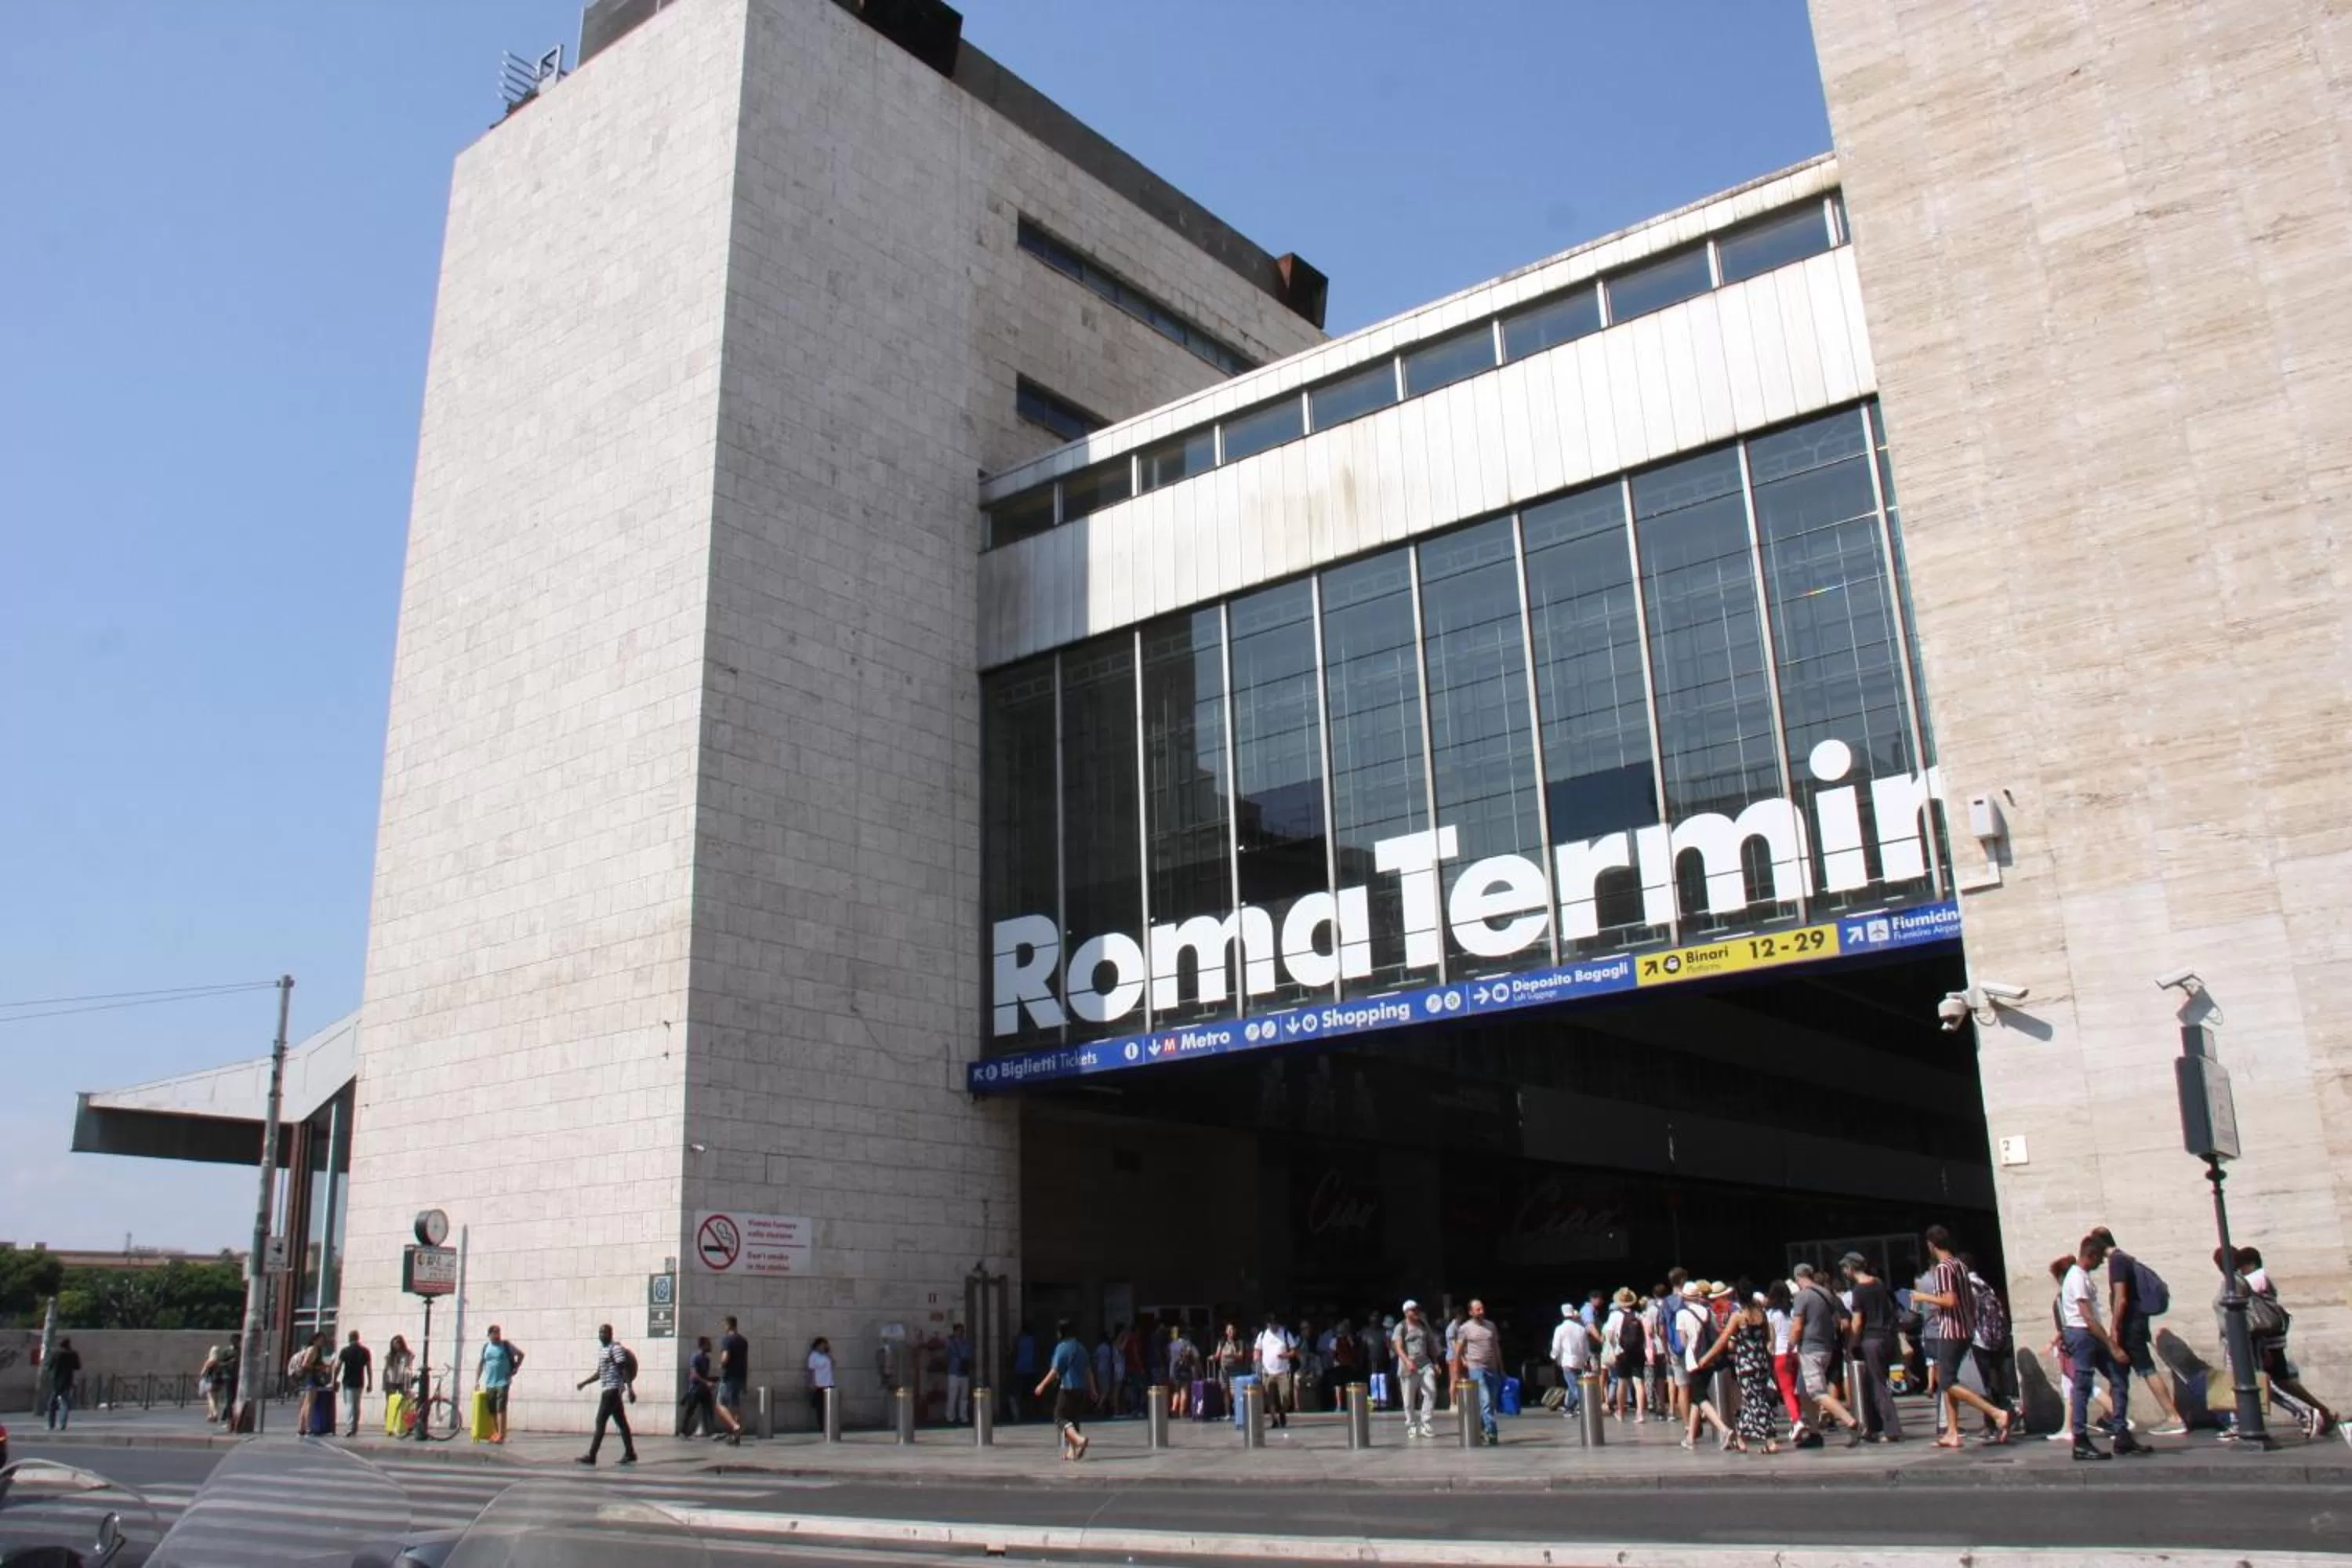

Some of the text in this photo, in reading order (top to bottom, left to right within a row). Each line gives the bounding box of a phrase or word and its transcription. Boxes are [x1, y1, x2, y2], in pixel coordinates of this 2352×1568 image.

[1892, 909, 1961, 930] Fiumicin
[1933, 923, 1961, 935] Airpor
[1686, 946, 1729, 964] Binari
[1749, 938, 1776, 960] 12
[1794, 930, 1825, 953] 29
[1512, 961, 1629, 993] Deposito Bagagli
[1322, 1001, 1411, 1029] Shopping
[1164, 1031, 1231, 1052] M Metro
[1001, 1051, 1098, 1079] Biglietti Tickets
